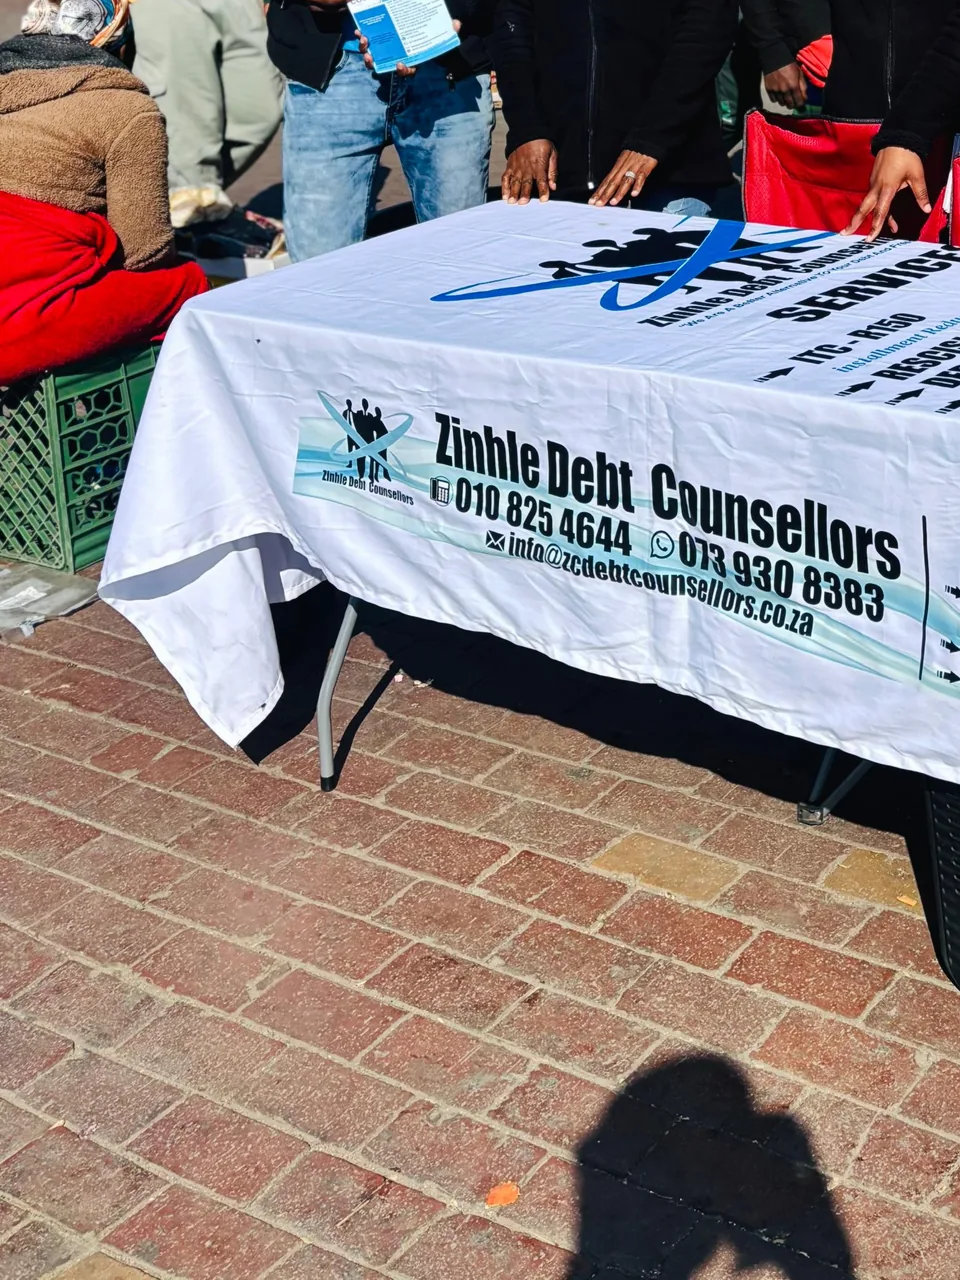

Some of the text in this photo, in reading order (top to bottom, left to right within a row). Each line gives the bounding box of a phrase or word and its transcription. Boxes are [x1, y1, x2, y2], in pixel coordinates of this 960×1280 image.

[637, 296, 734, 328] Zinhle
[717, 274, 794, 297] Debt
[788, 343, 852, 365] ITC
[847, 312, 926, 341] R150
[832, 331, 928, 374] installment
[321, 469, 415, 507] Zinhle Debt Counsellors
[435, 411, 902, 580] Zinhle Debt Counsellors
[455, 476, 885, 623] 010 825 4644 073 930 8383
[508, 531, 815, 638] info@zcdebtcounsellors.co.za
